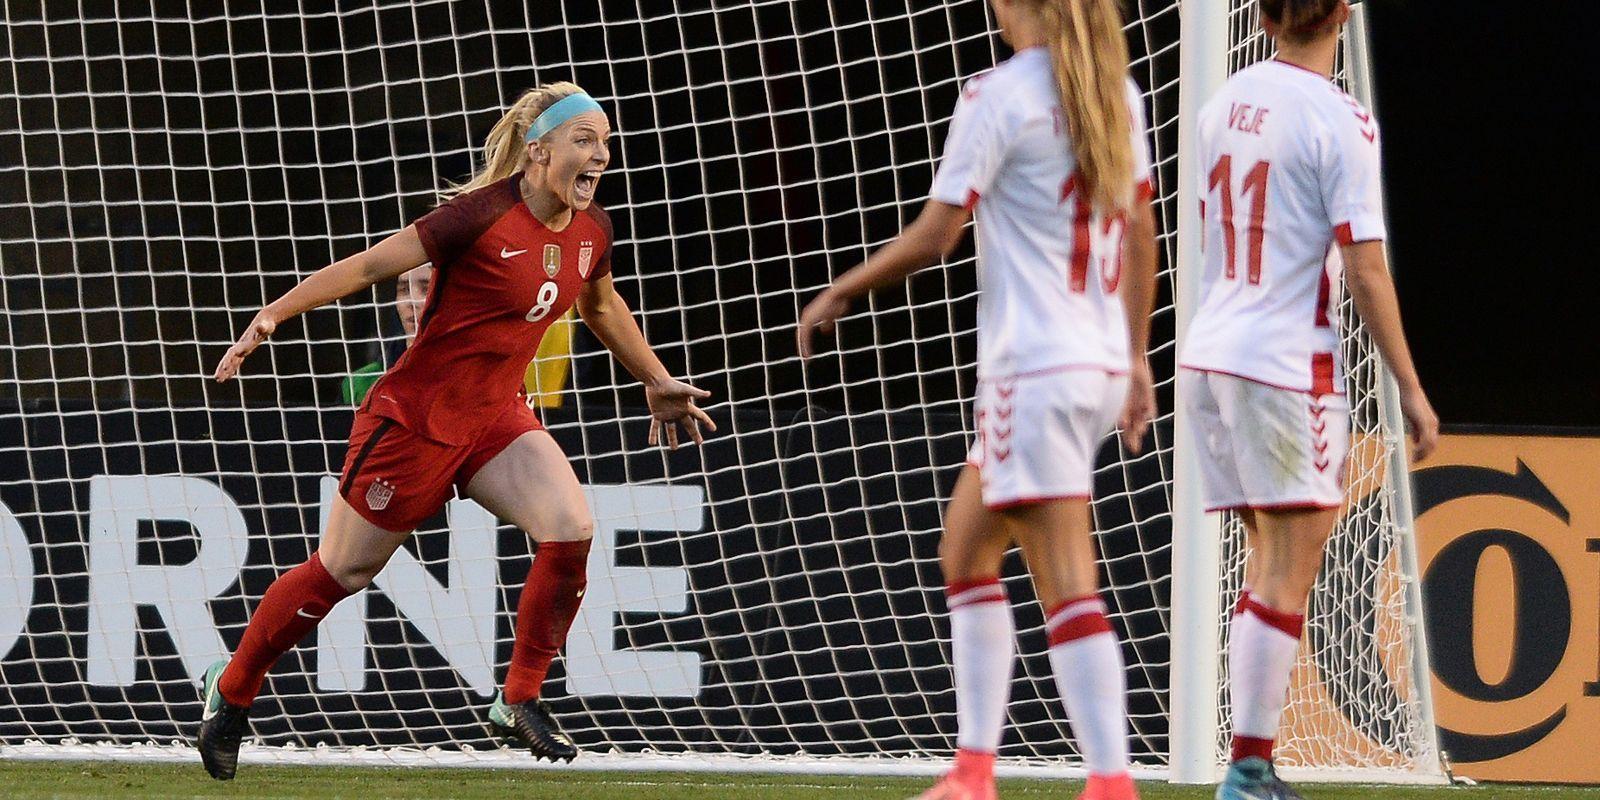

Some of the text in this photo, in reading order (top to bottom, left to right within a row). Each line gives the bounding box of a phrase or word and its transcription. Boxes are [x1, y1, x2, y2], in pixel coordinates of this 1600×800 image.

[1229, 102, 1270, 135] VEJE
[1208, 153, 1271, 286] 11
[525, 281, 559, 322] 8
[0, 474, 705, 698] RNE
